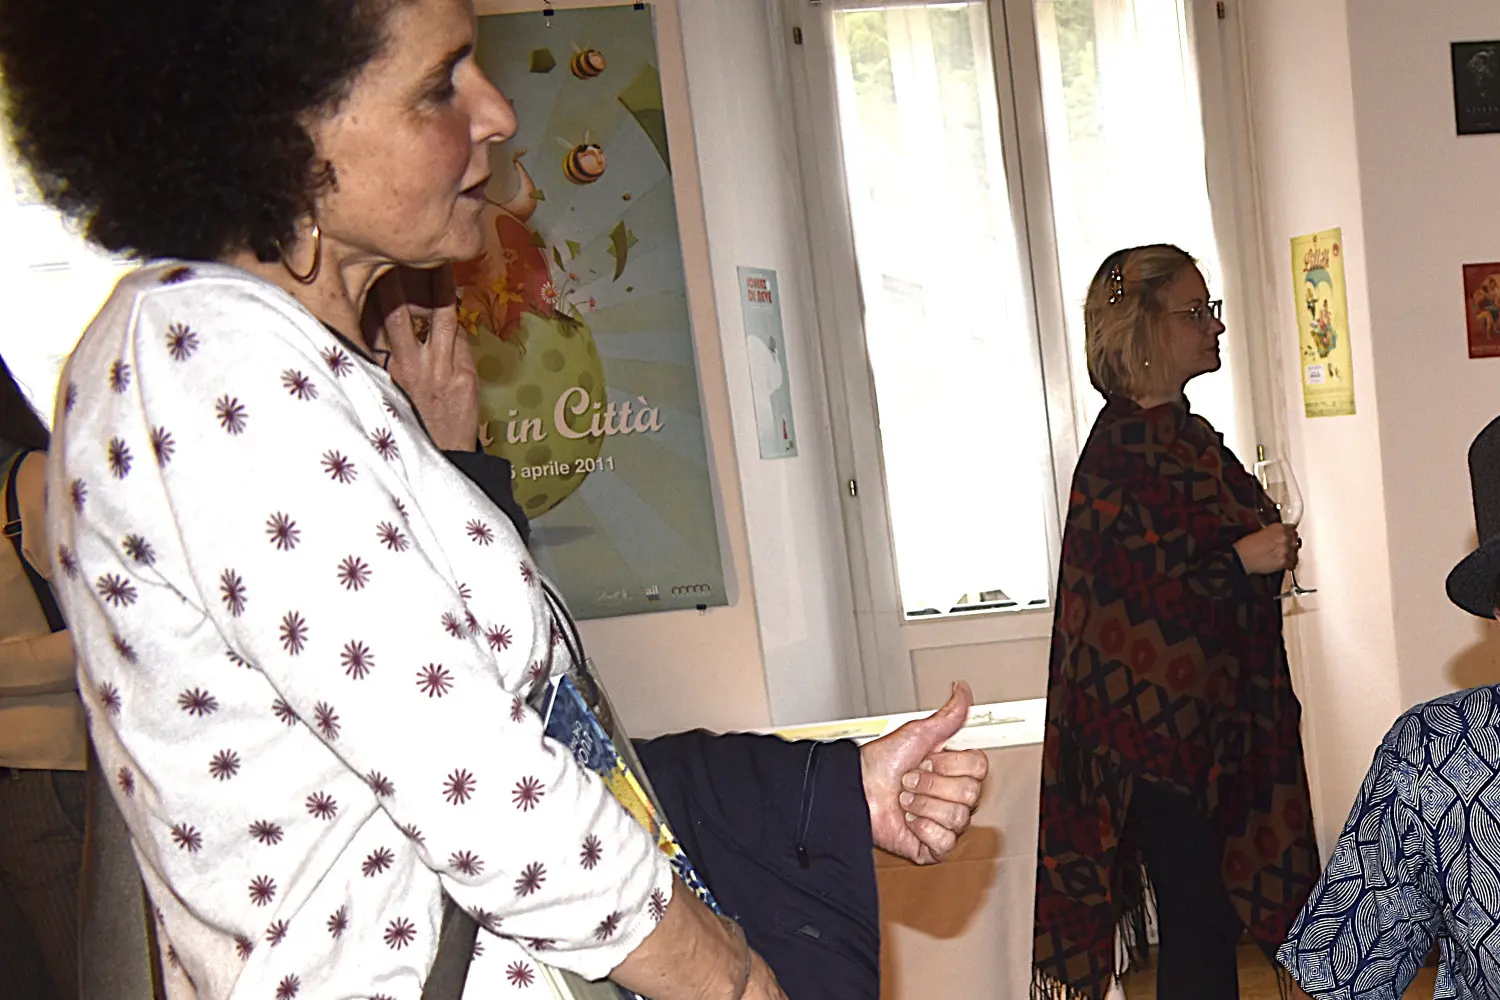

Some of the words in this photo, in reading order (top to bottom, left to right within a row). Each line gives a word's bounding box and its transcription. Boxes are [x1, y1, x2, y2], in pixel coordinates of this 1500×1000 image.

[506, 408, 547, 444] in
[554, 386, 664, 439] Città
[521, 461, 570, 480] aprile
[575, 456, 615, 472] 2011
